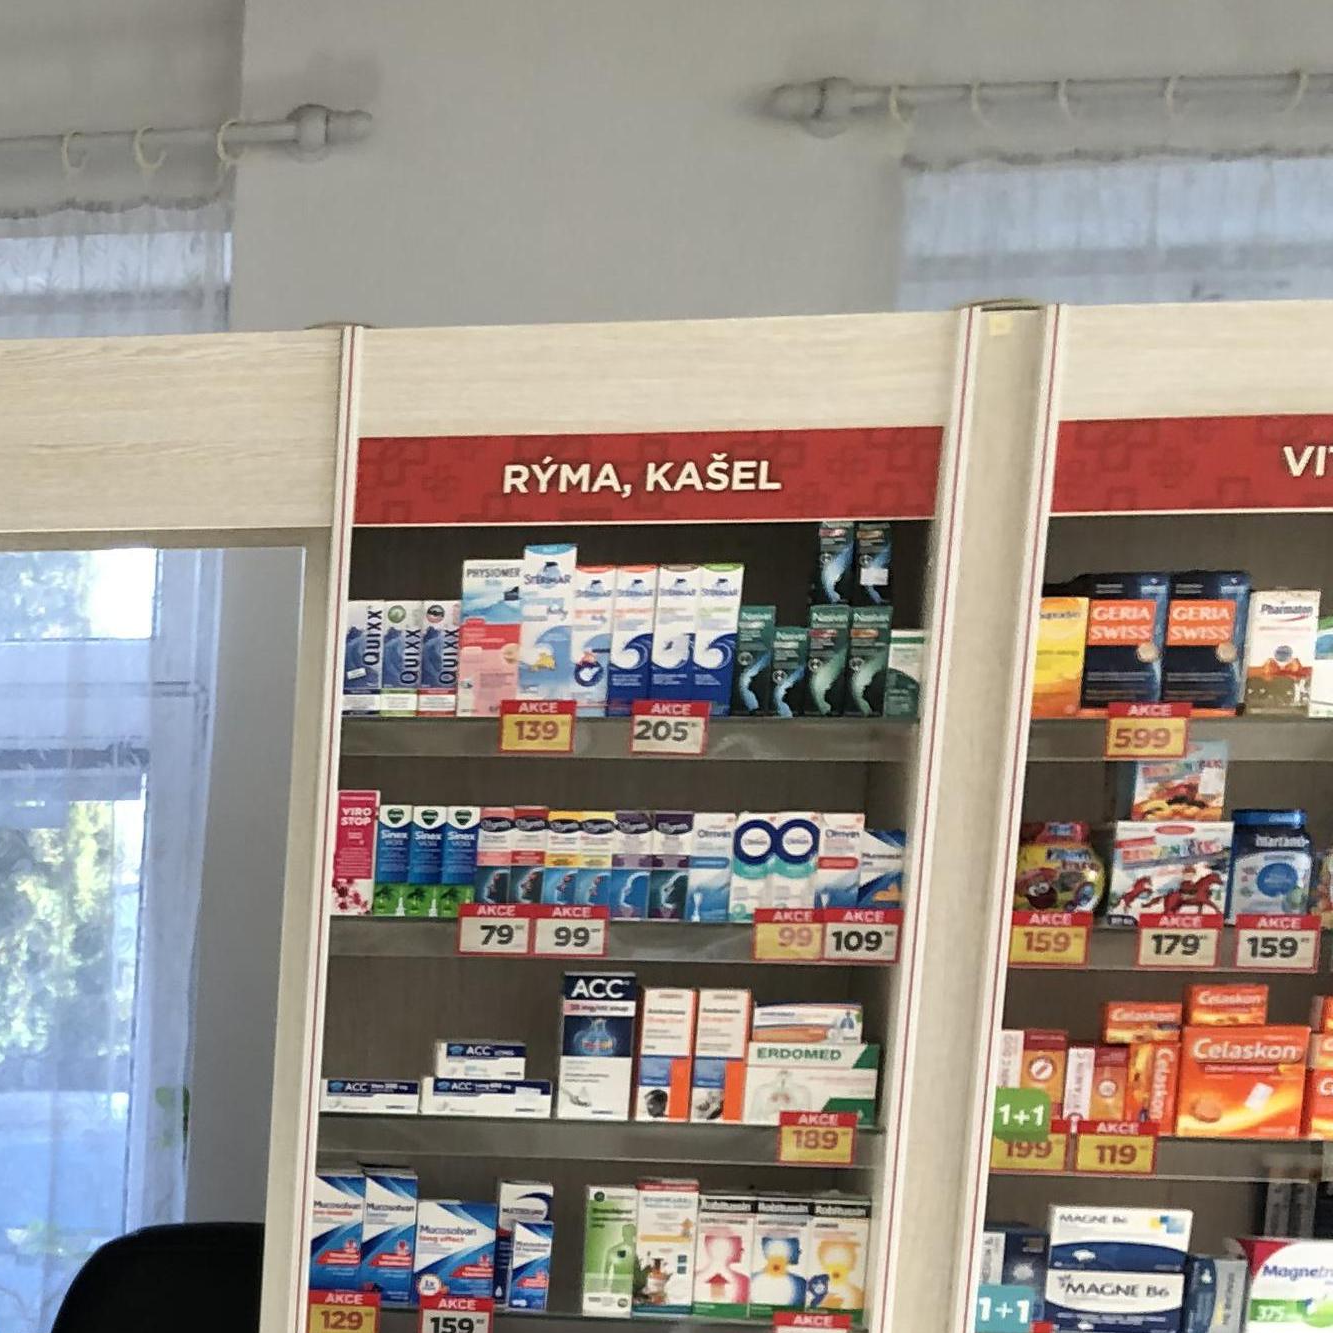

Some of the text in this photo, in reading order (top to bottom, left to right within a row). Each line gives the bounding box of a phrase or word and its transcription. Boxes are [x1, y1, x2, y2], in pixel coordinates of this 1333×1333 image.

[502, 454, 782, 498] RÝMA, KAŠEL
[1092, 606, 1150, 620] GERIA
[1172, 606, 1230, 620] GERIA
[1090, 625, 1150, 638] SWISS
[1170, 625, 1230, 638] SWISS
[651, 703, 692, 716] AKCE
[516, 721, 560, 741] 139
[634, 721, 689, 742] 205
[1113, 729, 1171, 749] 599
[341, 816, 371, 827] STOP
[551, 906, 591, 918] AKCE
[843, 911, 885, 923] AKCE
[1158, 916, 1202, 927] AKCE
[480, 925, 514, 945] 79
[554, 927, 591, 947] 99
[778, 928, 813, 948] 99
[832, 930, 883, 951] 109
[1023, 932, 1071, 953] 159
[1151, 934, 1200, 956] 179
[1246, 936, 1298, 959] 159
[570, 979, 626, 999] ACC
[756, 1049, 843, 1061] ERDOMED
[1193, 1038, 1298, 1063] Celaskon
[798, 1114, 839, 1126] AKCE
[997, 1102, 1045, 1126] 1+1
[792, 1130, 839, 1150] 189
[1095, 1143, 1137, 1164] 119
[418, 1223, 478, 1237] Mucosolvan
[1063, 1281, 1170, 1297] MAGNE B6
[438, 1298, 476, 1310] AKCE
[978, 1297, 1031, 1323] 1+1
[321, 1311, 363, 1330] 129
